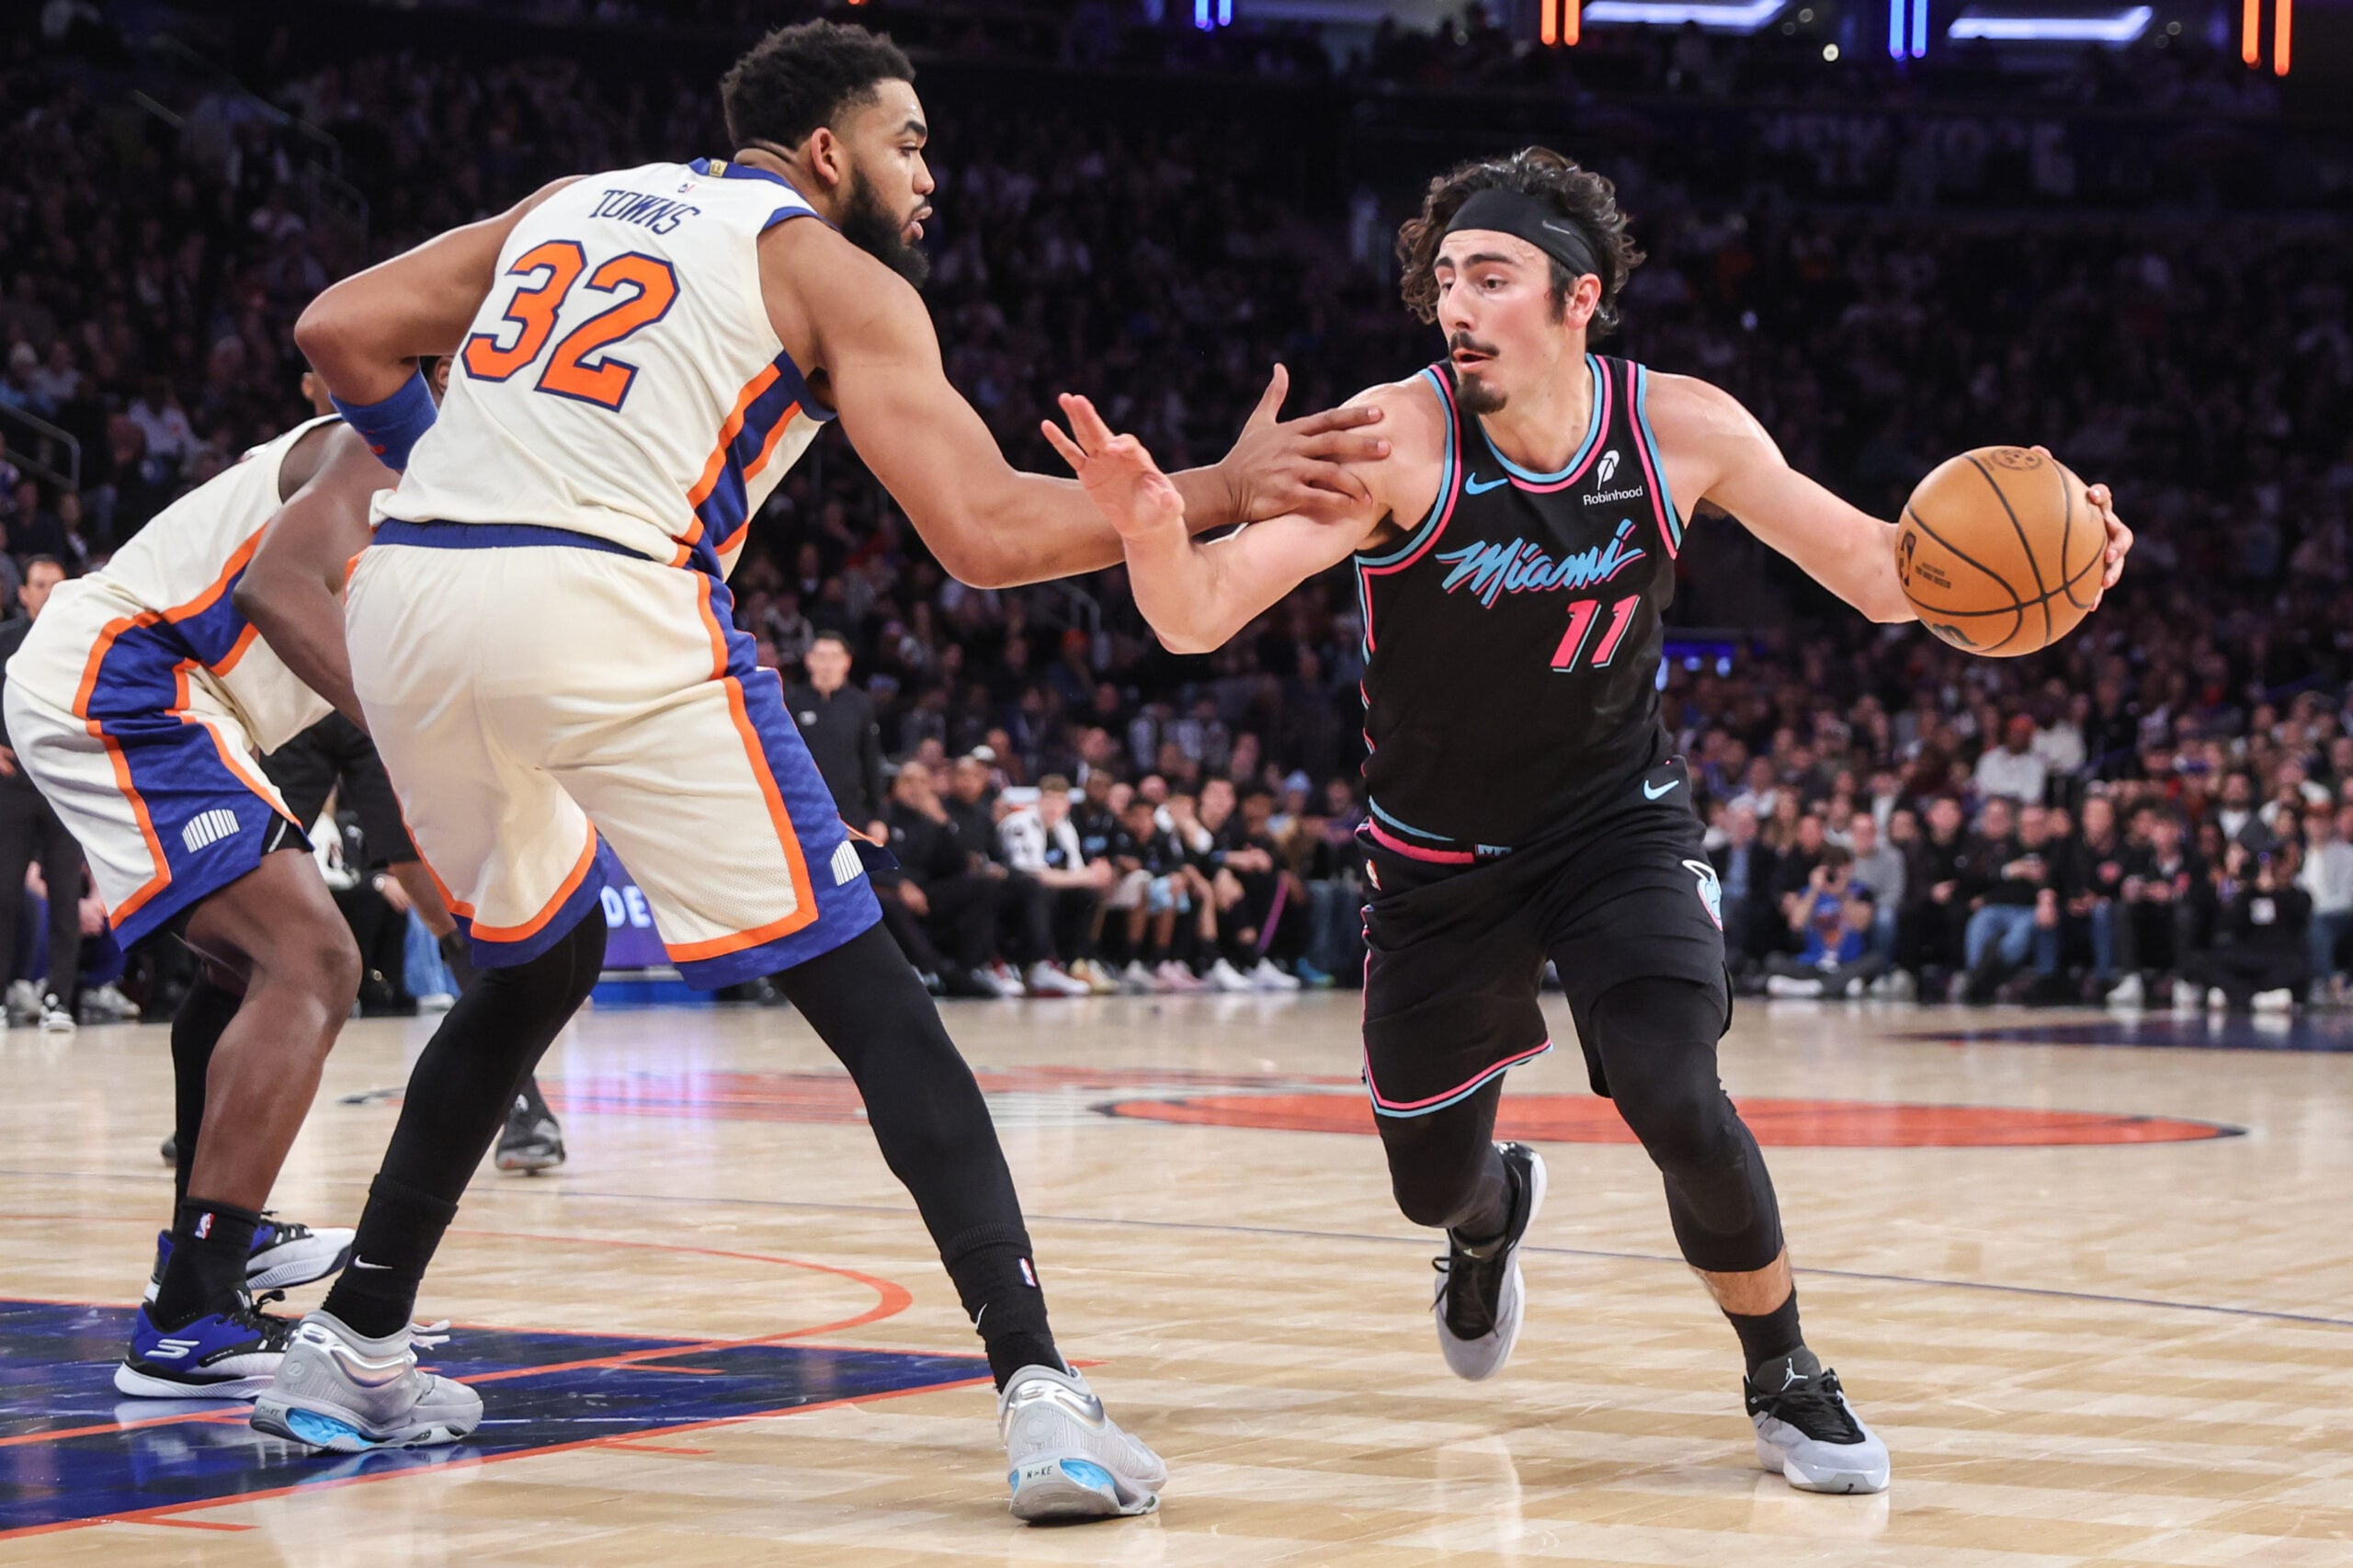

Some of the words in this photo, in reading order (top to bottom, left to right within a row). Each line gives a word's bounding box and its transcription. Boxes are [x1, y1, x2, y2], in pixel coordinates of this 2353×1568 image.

[589, 189, 700, 235] TOWNS
[460, 239, 680, 413] 32
[1583, 485, 1643, 506] Robinhood
[1434, 518, 1646, 610] Miami
[1550, 594, 1641, 673] 11
